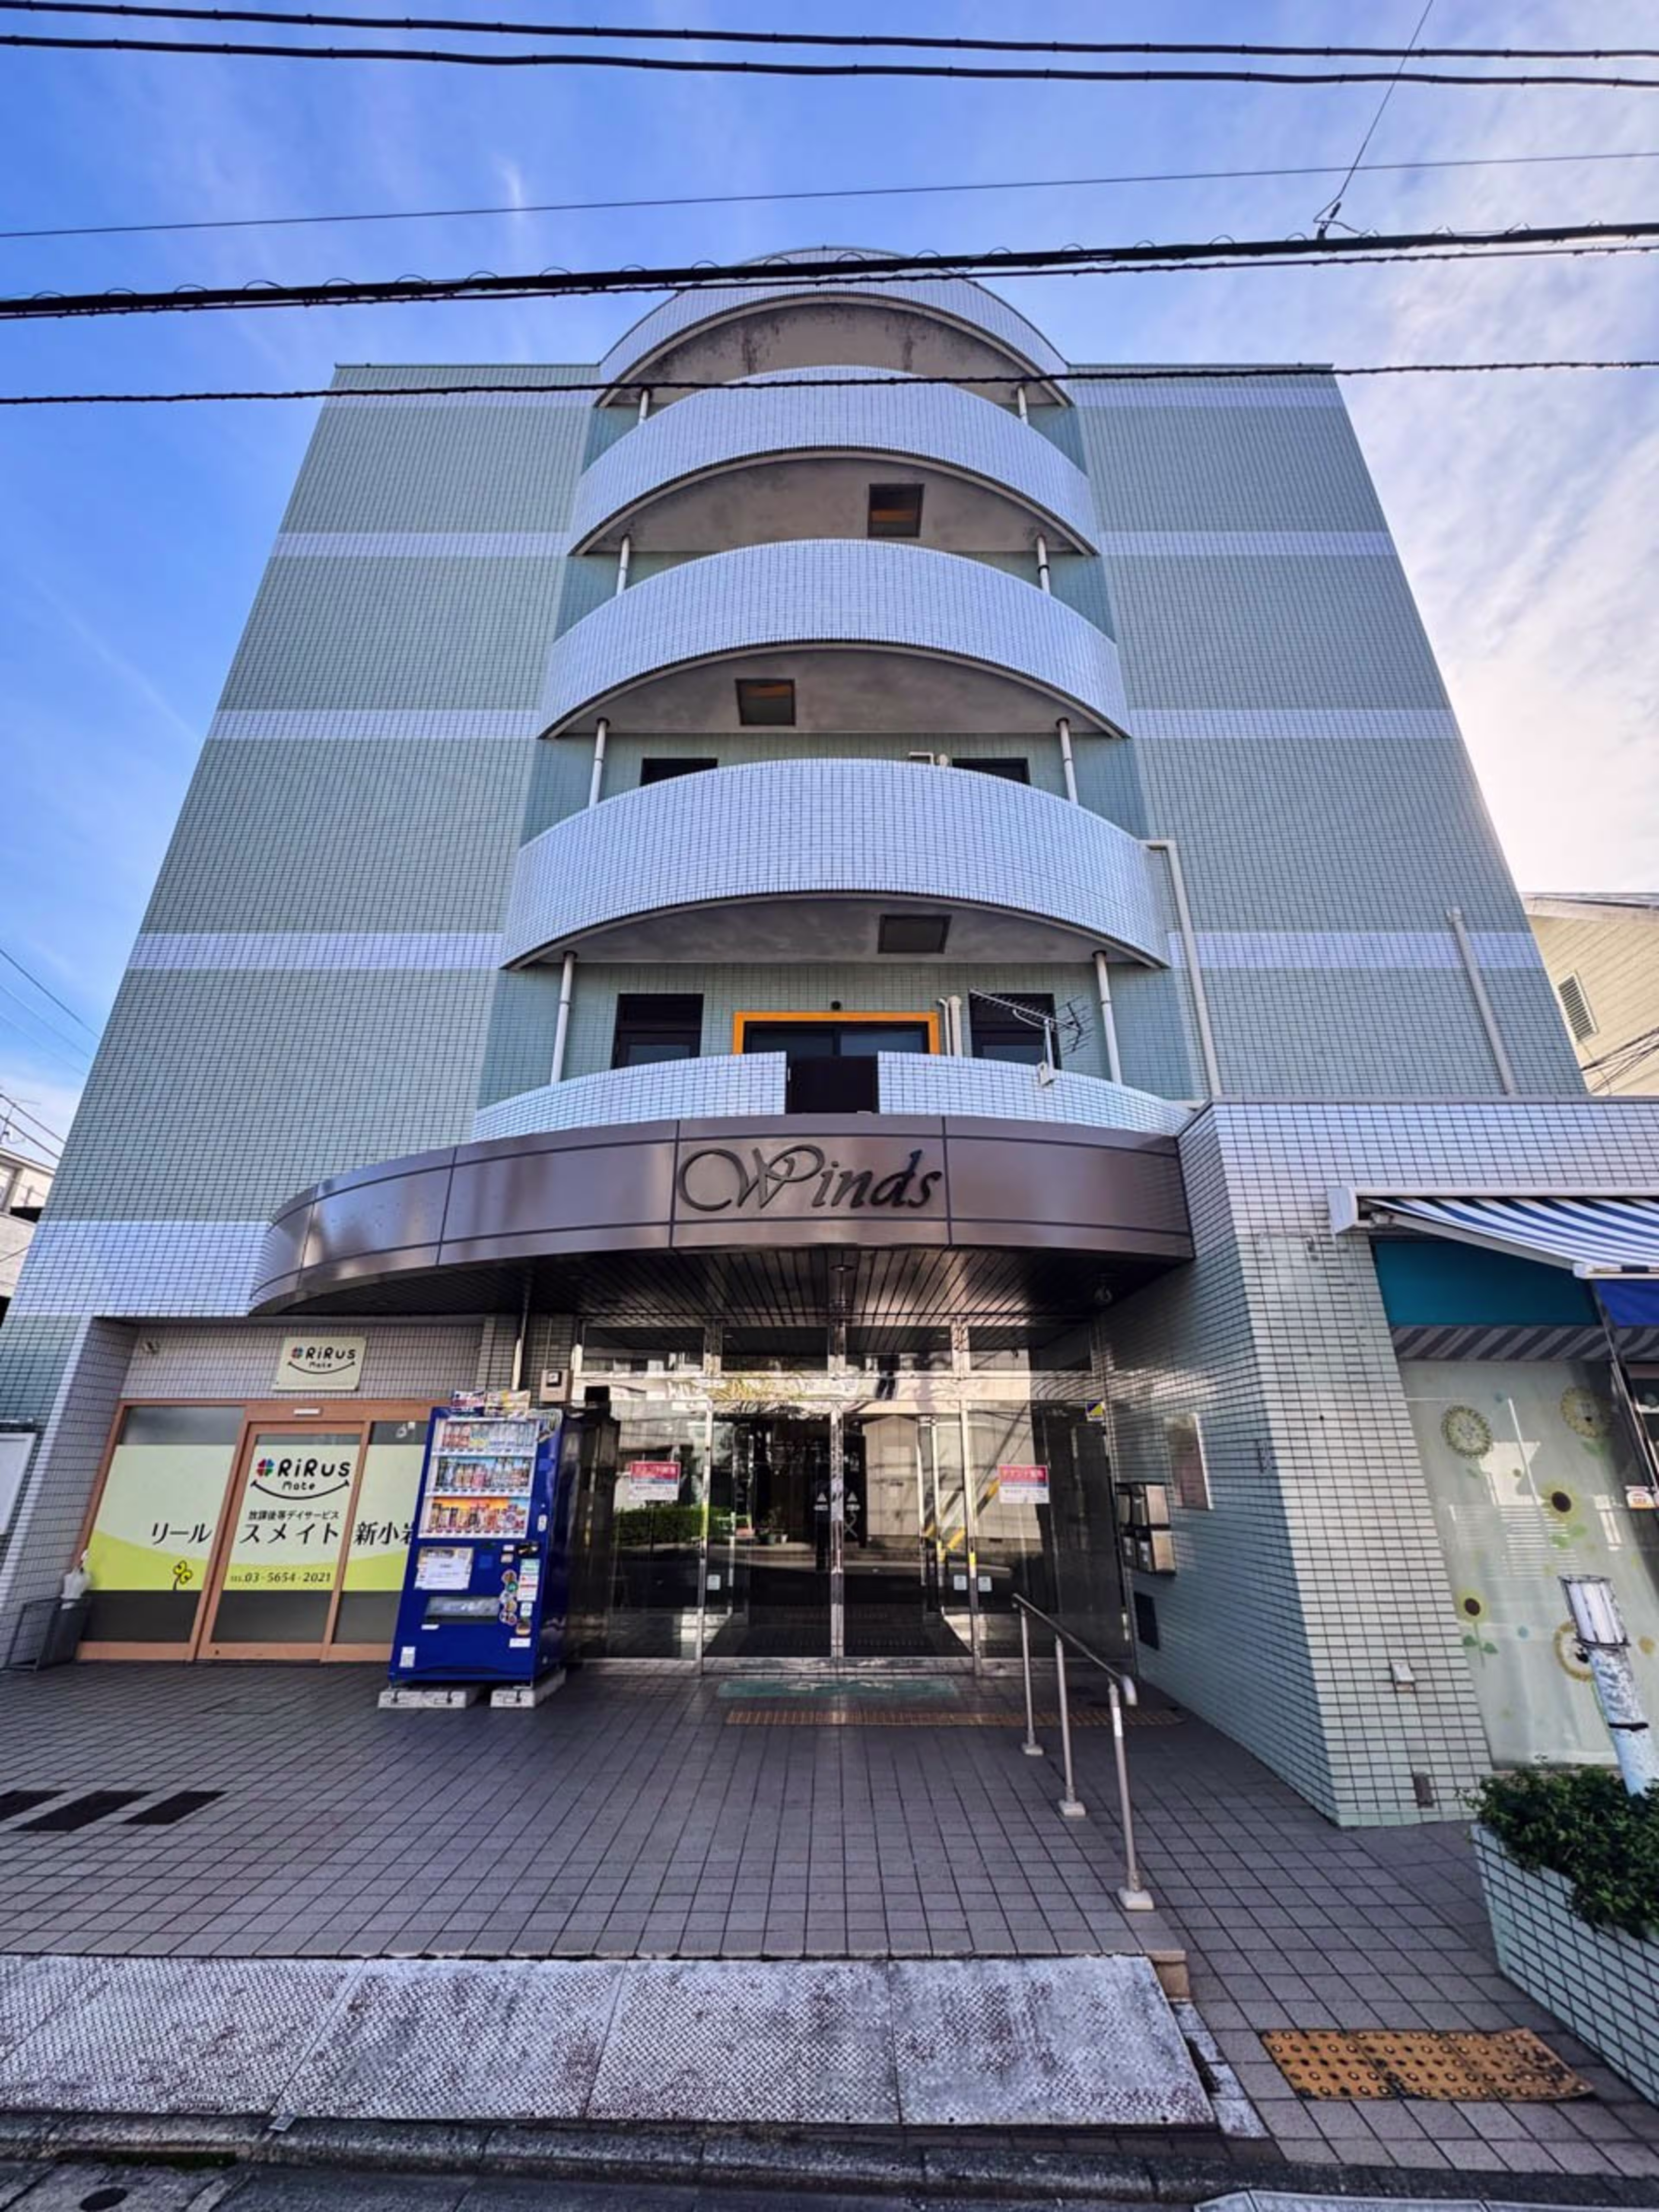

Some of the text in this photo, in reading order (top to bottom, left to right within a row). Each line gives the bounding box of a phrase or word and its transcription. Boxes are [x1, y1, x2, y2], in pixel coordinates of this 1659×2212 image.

[677, 1143, 942, 1212] Winds
[305, 1346, 356, 1360] RiRus
[277, 1458, 351, 1477] RiRus
[152, 1522, 213, 1545] リール
[239, 1522, 338, 1545] スメイト
